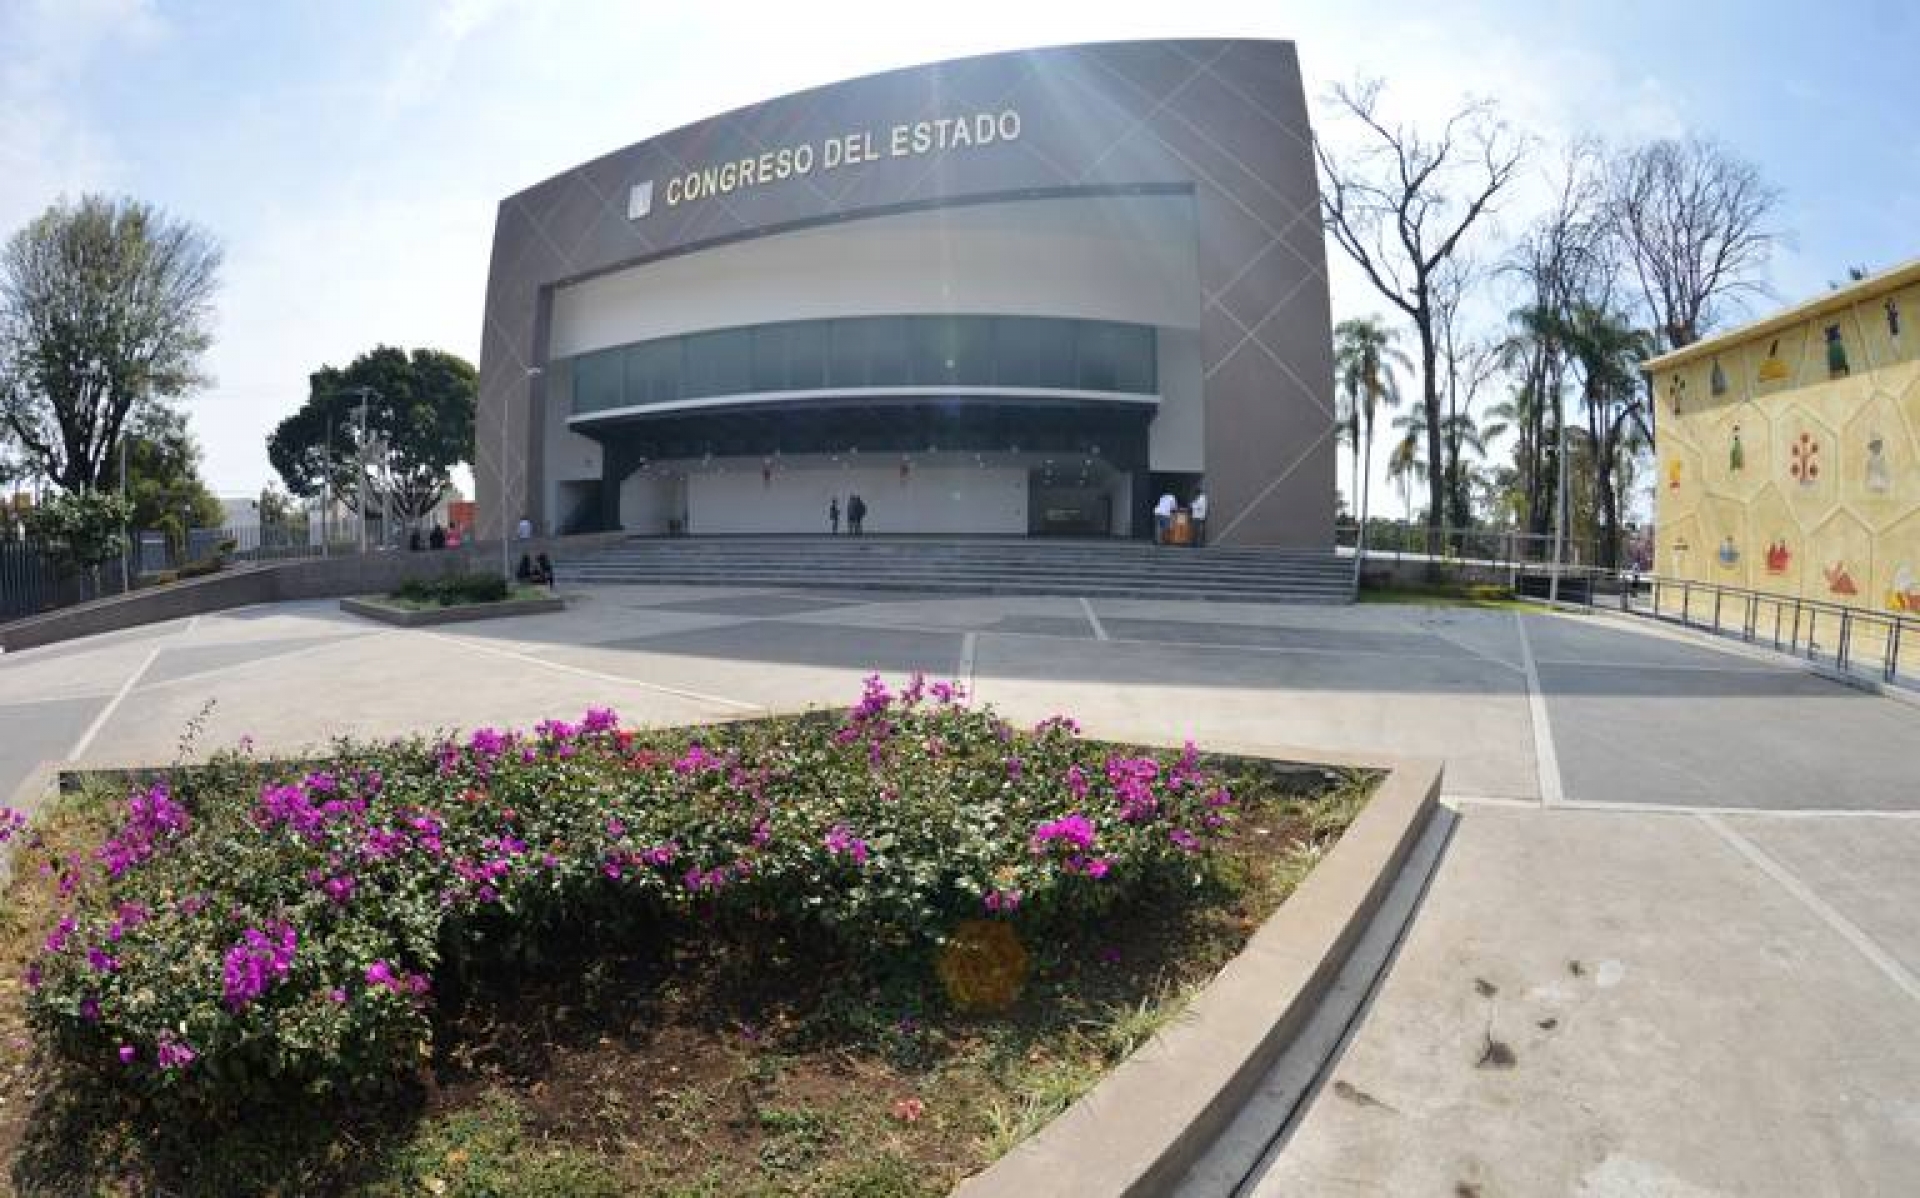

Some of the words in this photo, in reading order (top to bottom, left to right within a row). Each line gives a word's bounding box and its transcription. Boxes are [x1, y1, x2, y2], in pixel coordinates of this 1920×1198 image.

[666, 144, 813, 205] CONGRESO
[824, 132, 880, 168] DEL
[891, 109, 1021, 156] ESTADO
